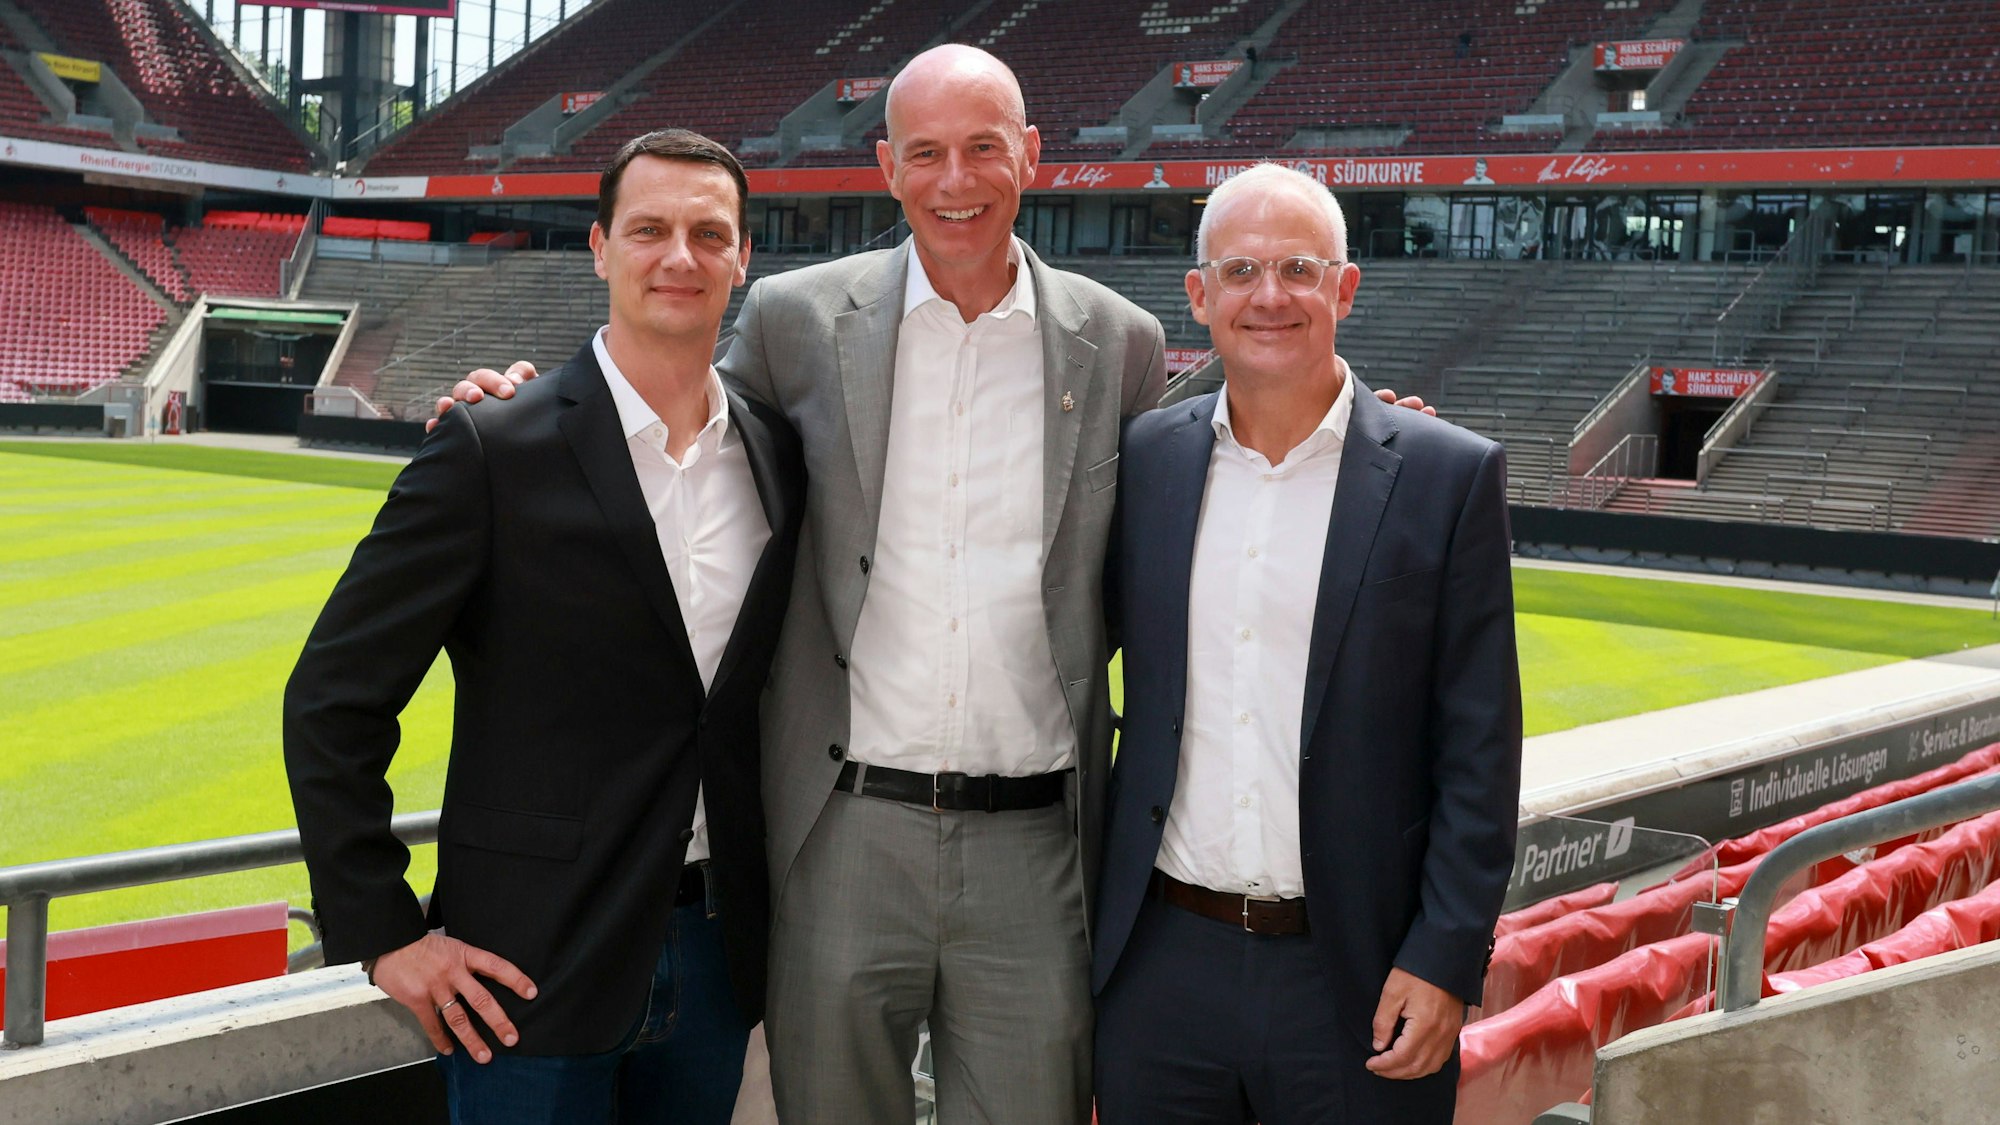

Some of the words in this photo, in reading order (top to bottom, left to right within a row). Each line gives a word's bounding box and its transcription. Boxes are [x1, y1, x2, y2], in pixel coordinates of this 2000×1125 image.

[1619, 44, 1642, 54] HANS
[1619, 53, 1664, 66] SÜDKURVE
[1194, 64, 1212, 73] HANS
[1332, 160, 1424, 185] SÜDKURVE
[1687, 371, 1713, 383] HANS
[1715, 370, 1757, 385] SCHÄFER
[1687, 383, 1735, 395] SÜDKURVE
[1921, 721, 1959, 758] Service
[1959, 717, 1967, 745] &
[1749, 757, 1830, 812] Individuelle
[1831, 747, 1888, 785] Lösungen
[1520, 831, 1603, 887] Partner
